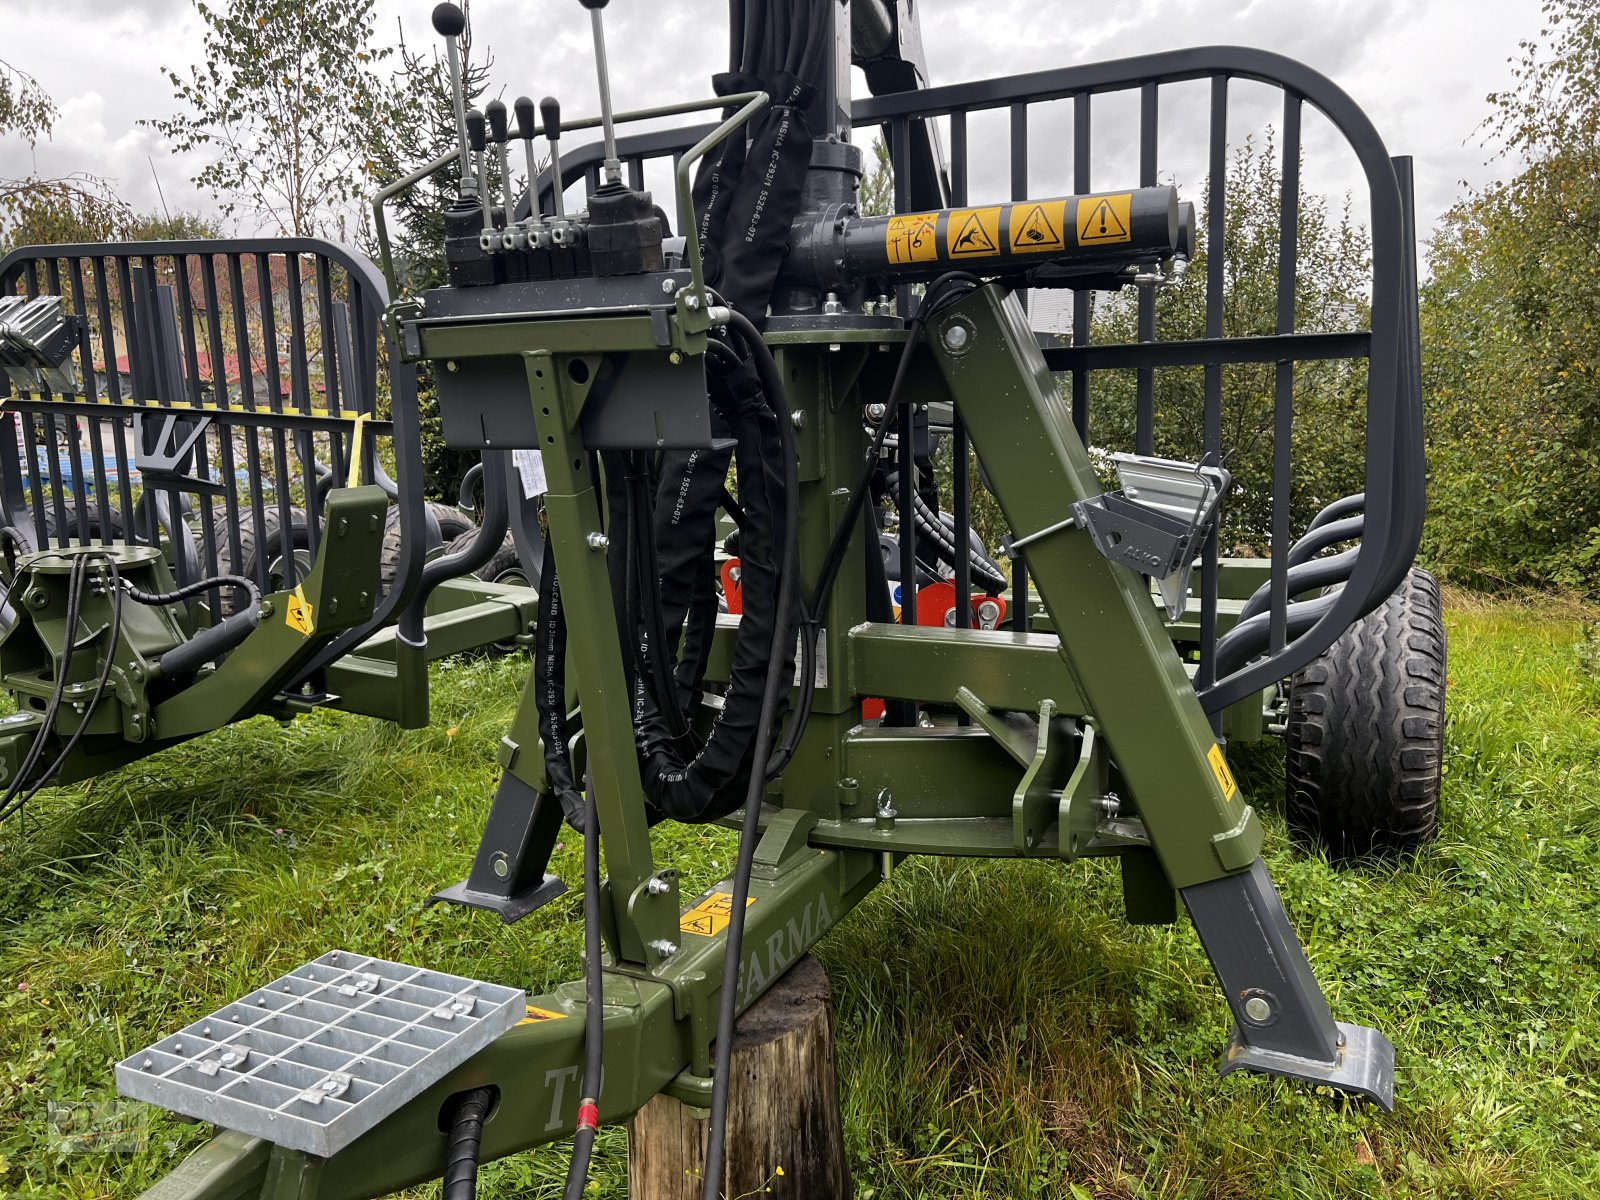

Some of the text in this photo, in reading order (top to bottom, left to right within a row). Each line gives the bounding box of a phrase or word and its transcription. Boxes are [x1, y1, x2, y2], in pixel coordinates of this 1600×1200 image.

[712, 173, 719, 182] ID
[745, 120, 789, 243] MSHA IC-293/1 5526-63-078
[699, 213, 711, 239] MSHA
[671, 477, 691, 525] 5526-63-078
